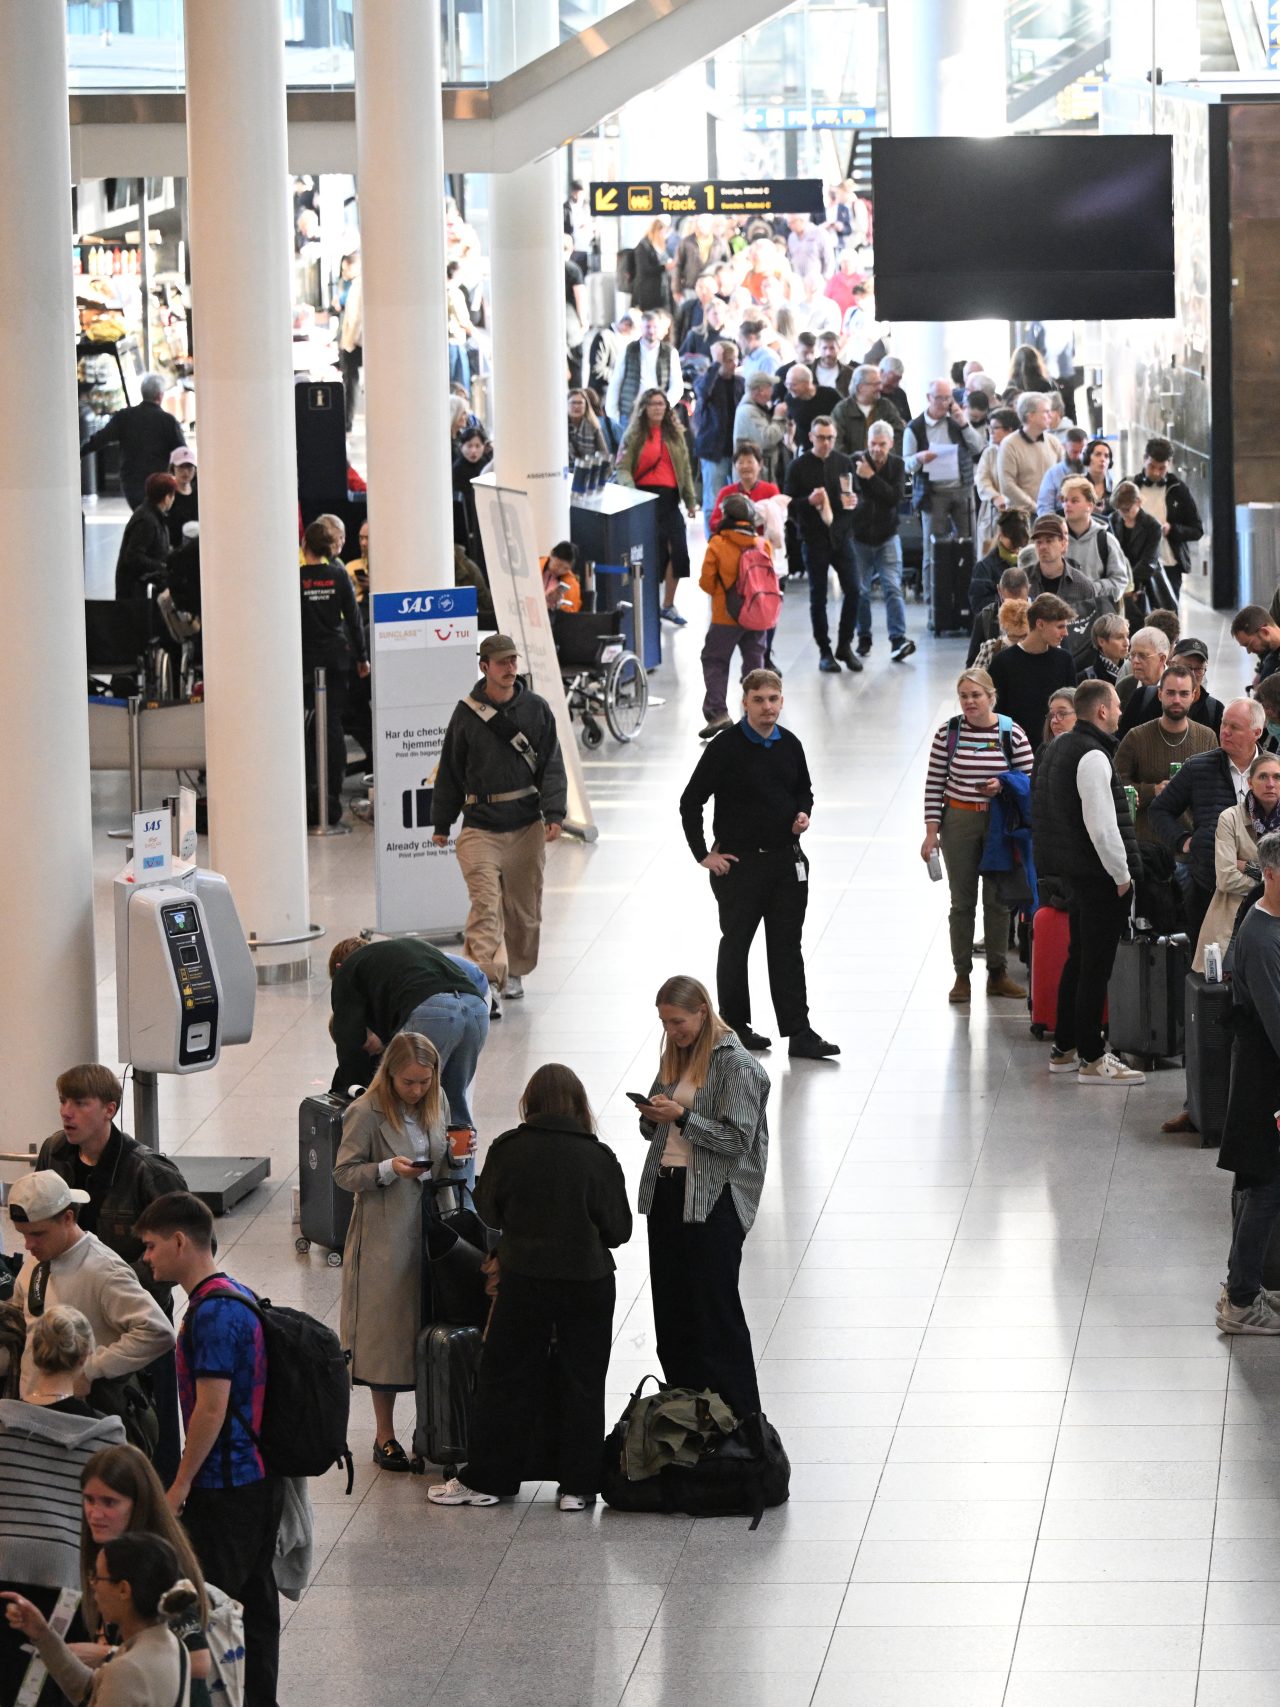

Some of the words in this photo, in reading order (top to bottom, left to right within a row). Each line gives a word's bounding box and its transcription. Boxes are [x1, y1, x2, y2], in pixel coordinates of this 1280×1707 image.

[661, 183, 690, 197] Spor
[704, 185, 715, 210] 1
[661, 198, 696, 210] Track
[398, 596, 434, 614] SAS
[385, 731, 400, 739] Har
[144, 820, 162, 833] SAS
[386, 842, 419, 851] Already
